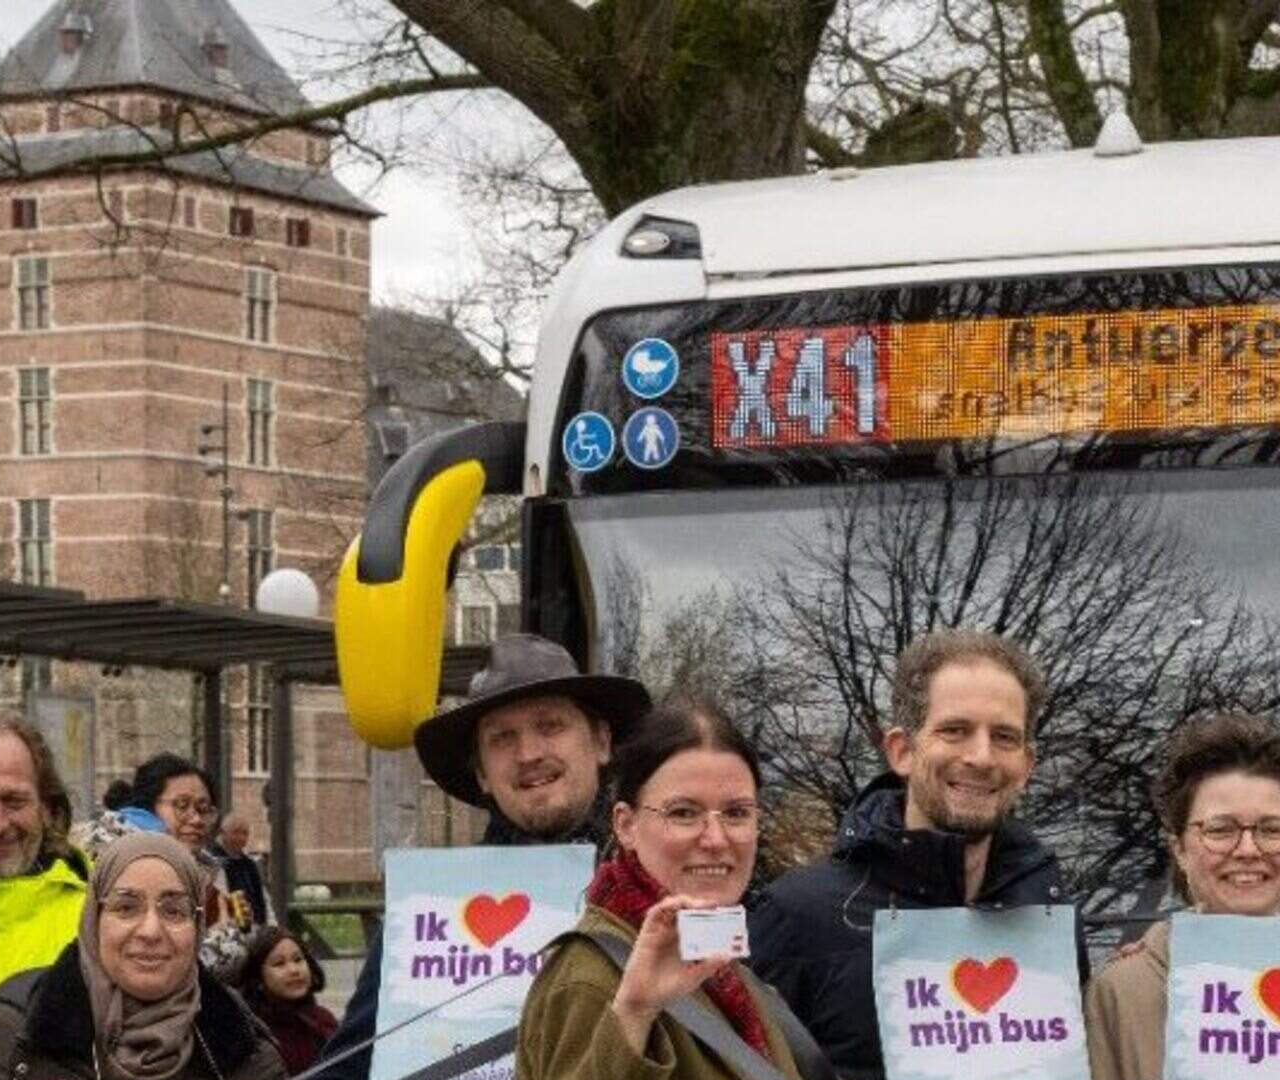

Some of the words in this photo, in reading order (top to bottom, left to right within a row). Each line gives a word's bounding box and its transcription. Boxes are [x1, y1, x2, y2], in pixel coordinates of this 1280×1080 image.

[727, 336, 875, 438] X41
[415, 911, 448, 942] Ik
[411, 945, 492, 986] mijn
[905, 977, 941, 1009] Ik
[1202, 981, 1242, 1016] Ik
[909, 1010, 992, 1053] mijn
[999, 1012, 1068, 1043] bus
